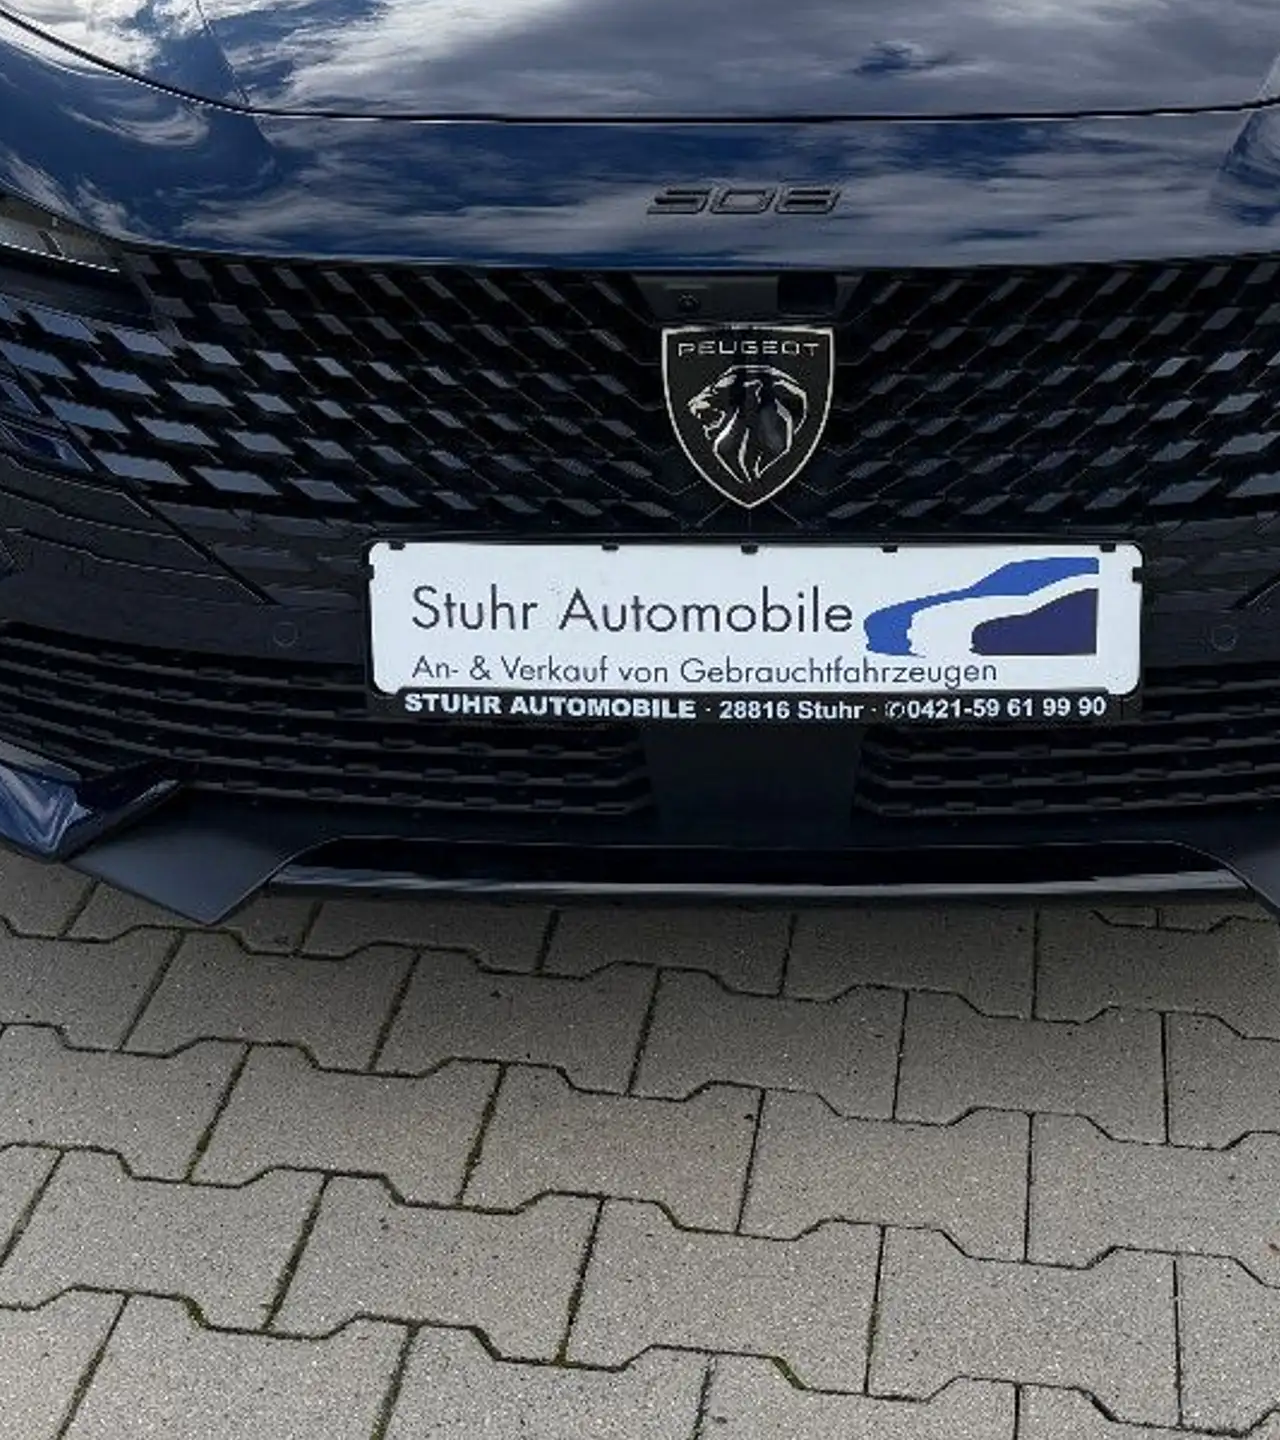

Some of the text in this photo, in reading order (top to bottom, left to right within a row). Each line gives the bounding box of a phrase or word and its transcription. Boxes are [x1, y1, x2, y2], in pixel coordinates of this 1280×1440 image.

[647, 186, 841, 215] 508
[677, 340, 821, 357] PEUGEOT
[411, 583, 854, 633] Stuhr Automobile
[411, 654, 998, 691] An- & Verkauf von Gebrauchtfahrzeugen
[404, 692, 501, 715] STUHR
[509, 696, 697, 720] AUTOMOBILE
[718, 700, 790, 720] 28816
[797, 701, 864, 720] Stuhr
[1006, 698, 1034, 717] 61
[1042, 697, 1074, 717] 99
[1078, 695, 1108, 716] 90
